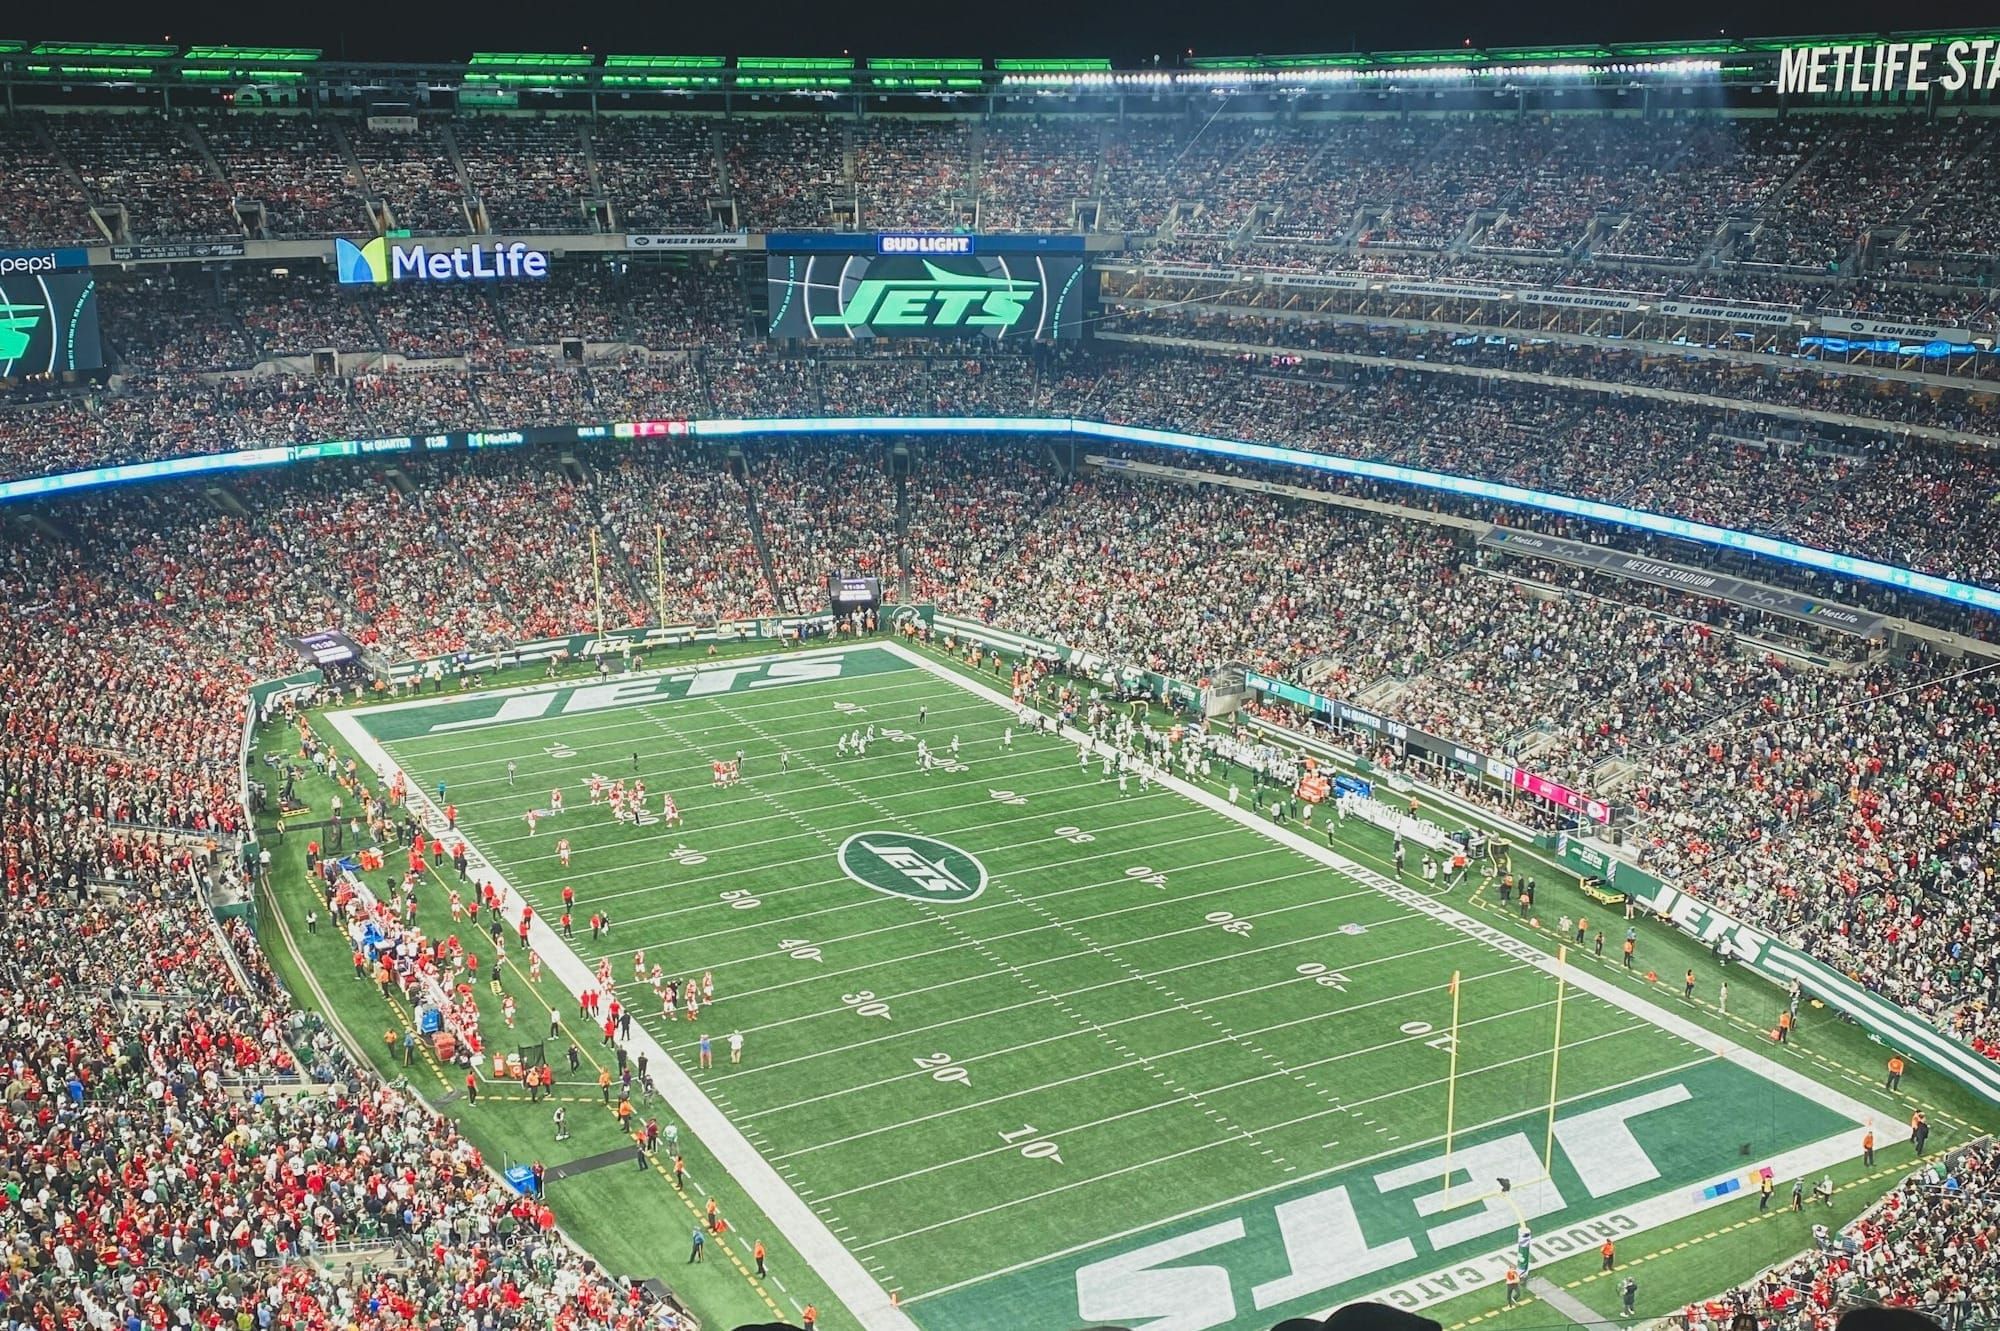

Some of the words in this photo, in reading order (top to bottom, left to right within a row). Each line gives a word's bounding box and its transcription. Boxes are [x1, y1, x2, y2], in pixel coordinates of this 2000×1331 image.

[1777, 43, 1932, 93] METLIFE
[883, 237, 919, 252] BUD
[919, 237, 969, 252] LIGHT
[0, 252, 57, 275] pepsi
[392, 242, 547, 279] MetLife
[812, 279, 1035, 325] JETS
[1526, 293, 1539, 301] 99
[1541, 294, 1573, 305] MARK
[1574, 297, 1631, 310] GASTINEAU
[1663, 305, 1678, 313] 60
[1688, 307, 1726, 318] LARRY
[1725, 311, 1788, 324] GRANTHAM
[1872, 325, 1904, 336] LEON
[1905, 327, 1938, 339] HESS
[375, 437, 412, 450] QUARTER
[484, 432, 523, 445] MetLife
[1511, 534, 1545, 549] MetLife
[1622, 558, 1670, 579] METLIFE
[1667, 566, 1715, 588] STADIUM
[1817, 605, 1859, 624] MetLife
[429, 655, 845, 731] JETS
[1054, 826, 1096, 844] 50
[669, 844, 708, 866] 40
[858, 840, 971, 892] JETS
[719, 889, 762, 910] 50
[1205, 911, 1254, 934] 30
[1340, 863, 1454, 915] INTERCEPT
[1454, 917, 1548, 964] CANCER
[1635, 884, 1768, 964] JETS
[778, 937, 823, 961] 40
[1296, 962, 1352, 988] 20
[841, 990, 891, 1018] 30
[1400, 1021, 1460, 1056] 10
[912, 1052, 969, 1083] 20
[998, 1123, 1060, 1159] 10
[1074, 1083, 1694, 1331] JETS
[1376, 1266, 1487, 1309] CATC
